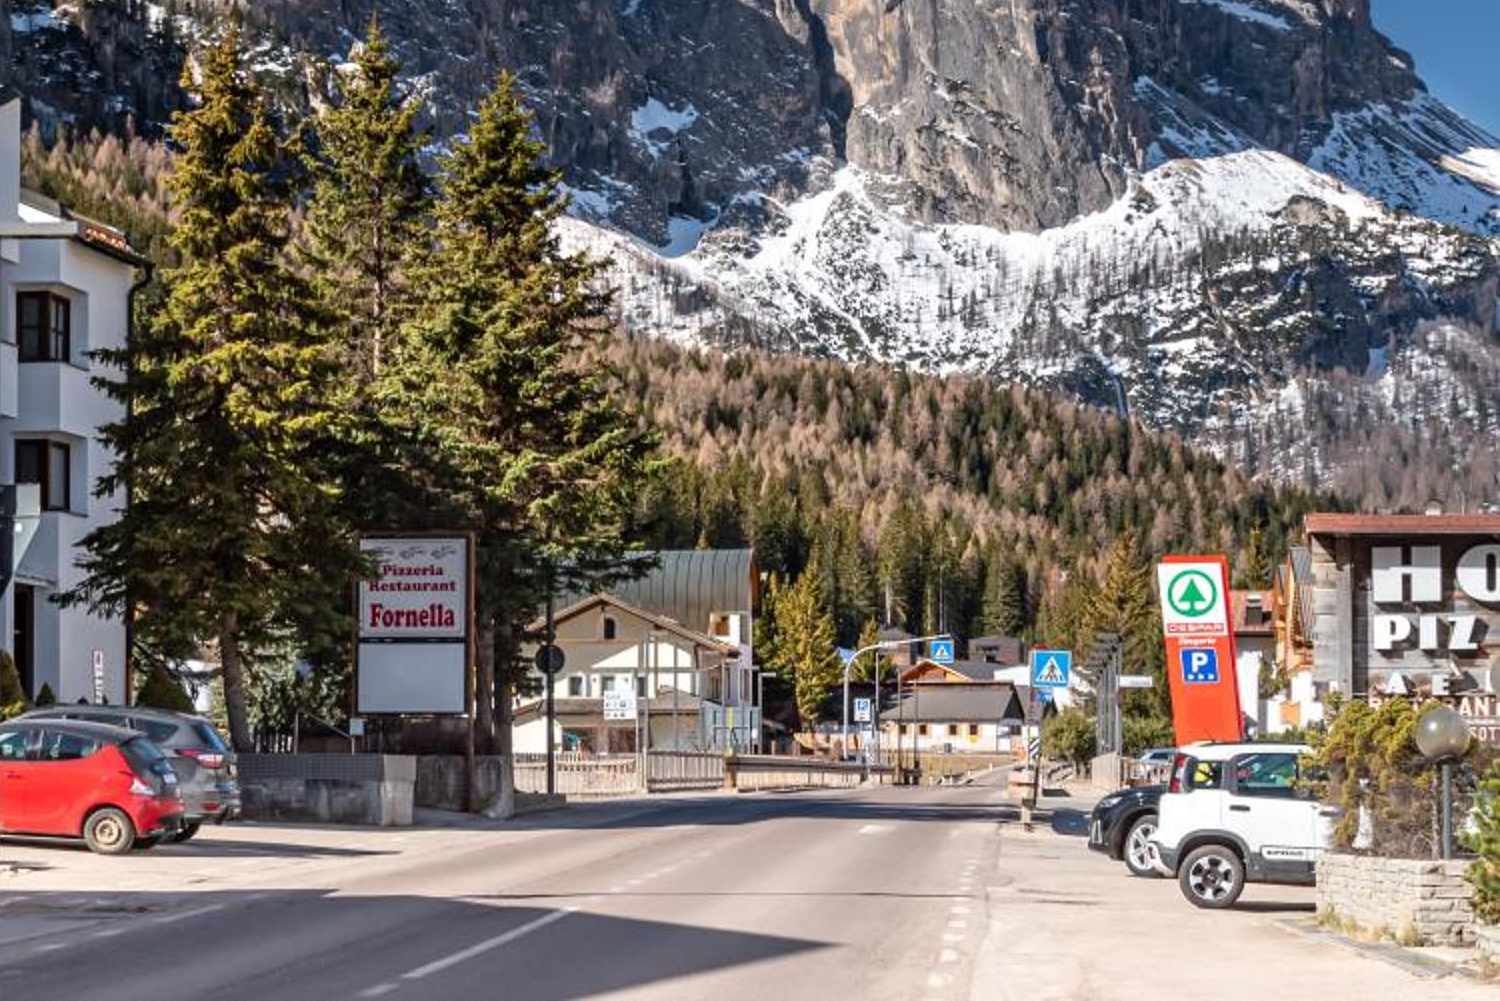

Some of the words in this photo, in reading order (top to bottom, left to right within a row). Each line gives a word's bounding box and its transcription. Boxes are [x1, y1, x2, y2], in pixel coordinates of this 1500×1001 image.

[382, 564, 444, 576] Pizzeria
[369, 580, 456, 592] Restaurant
[369, 603, 455, 628] Fornella
[1167, 623, 1223, 633] DESPAR
[1191, 652, 1209, 673] P
